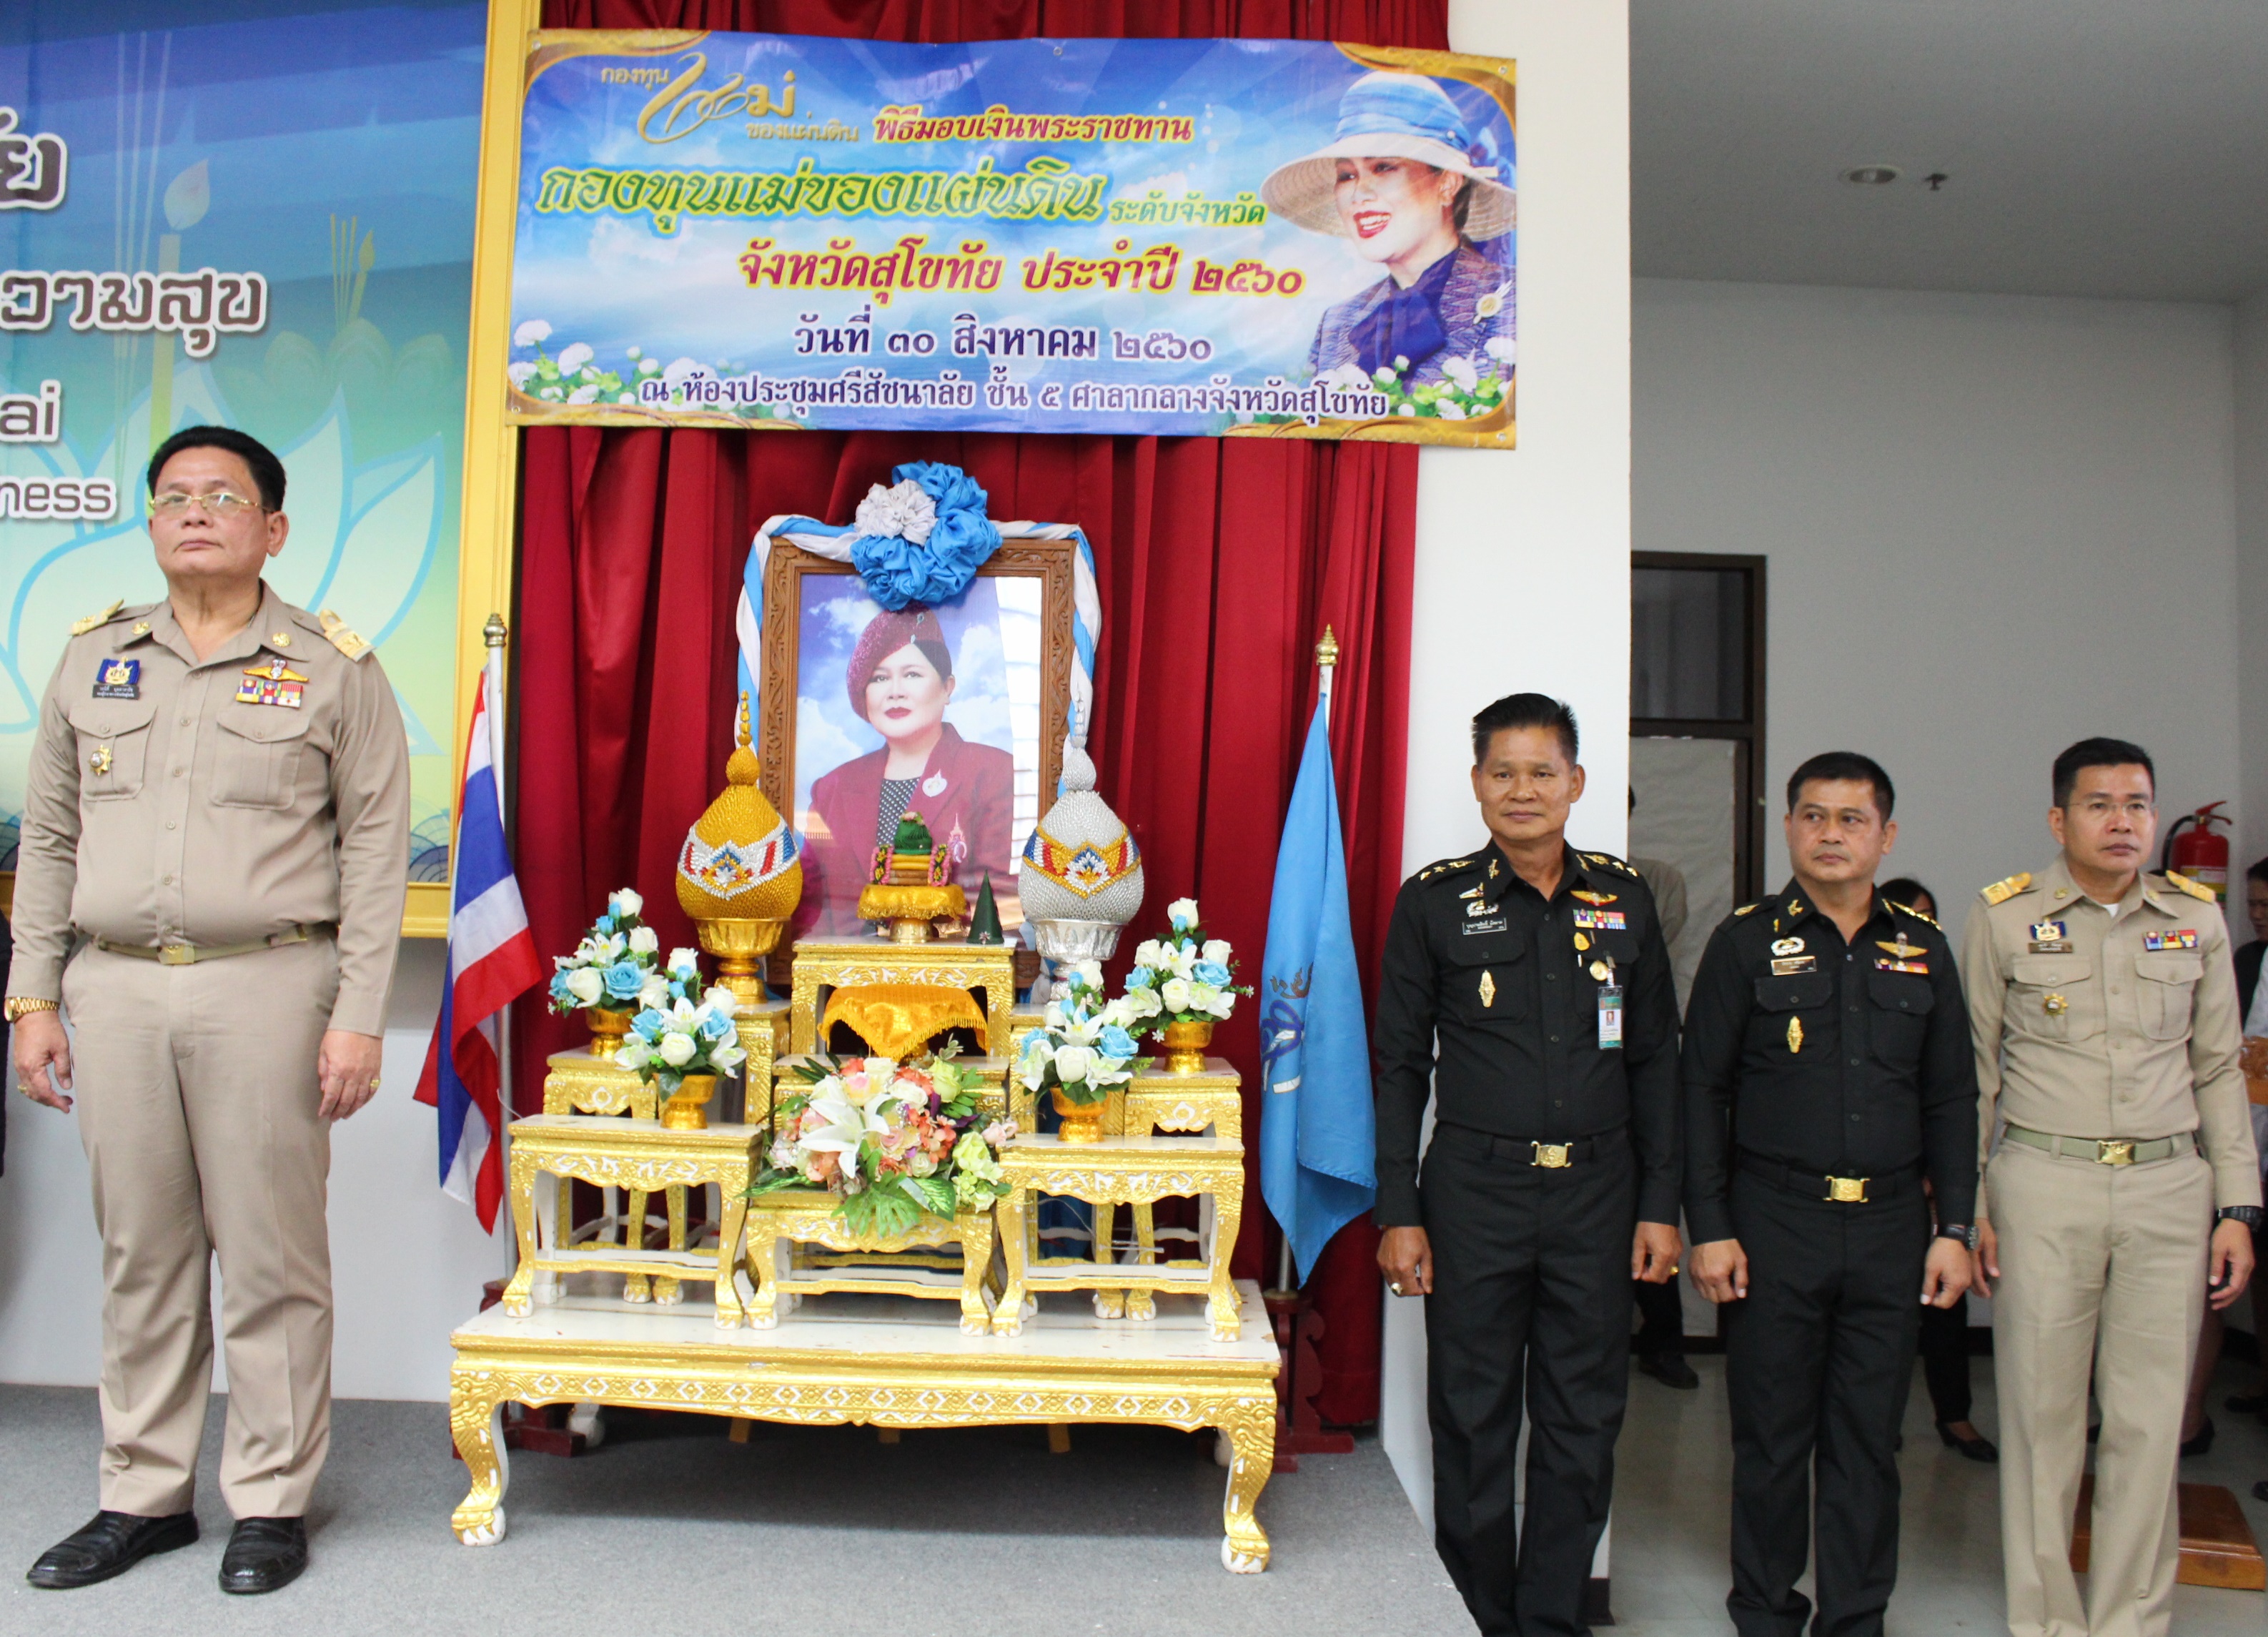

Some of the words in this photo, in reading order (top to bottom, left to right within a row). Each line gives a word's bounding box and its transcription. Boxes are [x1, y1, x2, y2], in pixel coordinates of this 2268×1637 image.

[601, 67, 670, 91] กองทุน
[746, 112, 859, 142] ของแผ่นดิน
[874, 107, 1193, 141] พิธีมอบเงินพระราชทาน
[537, 157, 1105, 231] กองทุนแม่ของแผ่นดิน
[1110, 192, 1265, 224] ระดับจังหวัด
[740, 237, 1004, 305] จังหวัดสุโขทัย
[1022, 239, 1180, 290] ประจำปี
[1192, 259, 1302, 294] ๒๕๖๐
[794, 304, 871, 354] วันที่
[887, 332, 935, 354] ๓๐
[954, 313, 1096, 357] สิงหาคม
[1114, 330, 1212, 360] ๒๕๖๐
[641, 380, 669, 401] ณ
[683, 370, 973, 417] ห้องประชุมศรีสัชนาลัย
[987, 365, 1028, 407] ชั้น
[1041, 385, 1060, 407] ๕
[1072, 378, 1387, 427] ศาลากลางจังหวัดสุโขทัย
